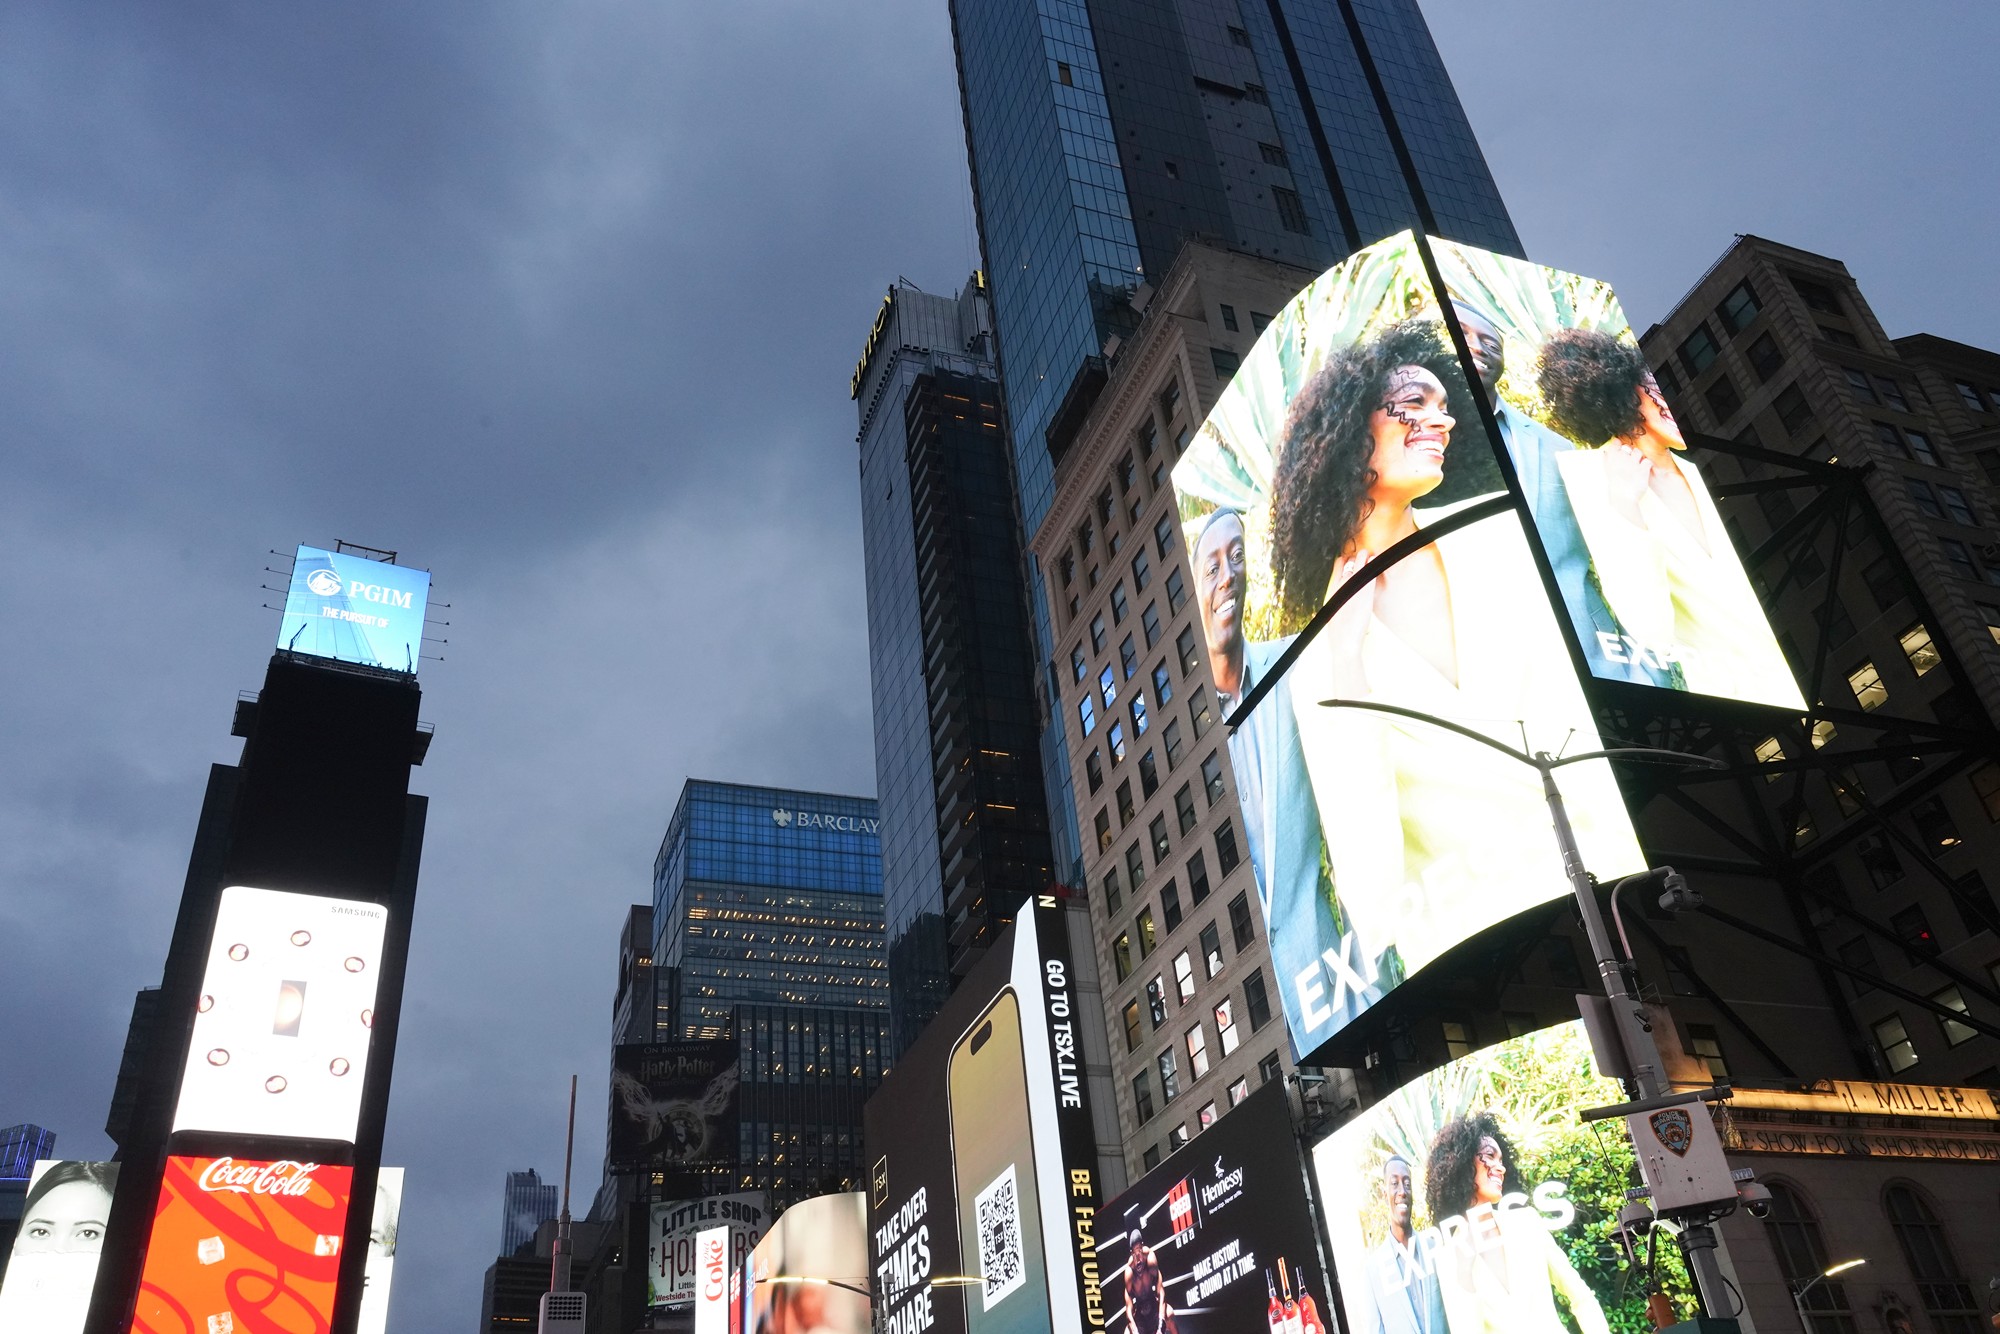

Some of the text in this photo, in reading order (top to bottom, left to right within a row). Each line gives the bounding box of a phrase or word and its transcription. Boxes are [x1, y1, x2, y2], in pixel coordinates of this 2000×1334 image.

[349, 580, 413, 609] PGIM
[322, 606, 390, 628] THE PURSUIT OF
[797, 812, 880, 834] BARCLAY
[331, 906, 380, 919] SAMSUNG
[1046, 959, 1082, 1109] GO TO TSX.LIVE
[641, 1055, 716, 1082] Harry Potter
[1871, 1084, 1973, 1113] MILLER
[1653, 1115, 1688, 1128] DEPARTMENT
[1657, 1111, 1679, 1119] POLICE
[1756, 1131, 1807, 1152] SHOW
[1815, 1134, 1871, 1155] FOLKS
[1875, 1136, 1923, 1157] SHOE
[1925, 1138, 1969, 1159] SHOP
[875, 1171, 886, 1193] TSX
[1070, 1168, 1092, 1197] BE
[1201, 1166, 1243, 1206] Hennessy
[662, 1200, 761, 1238] LITTLE SHOP
[875, 1186, 928, 1258] TAKE OVER
[994, 1230, 1004, 1245] TSX
[705, 1239, 724, 1302] Coke
[877, 1224, 931, 1312] TIMES
[1193, 1238, 1241, 1282] MAKE HISTORY
[1185, 1252, 1257, 1307] ONE ROUND AT A TIME
[656, 1289, 686, 1302] Westside
